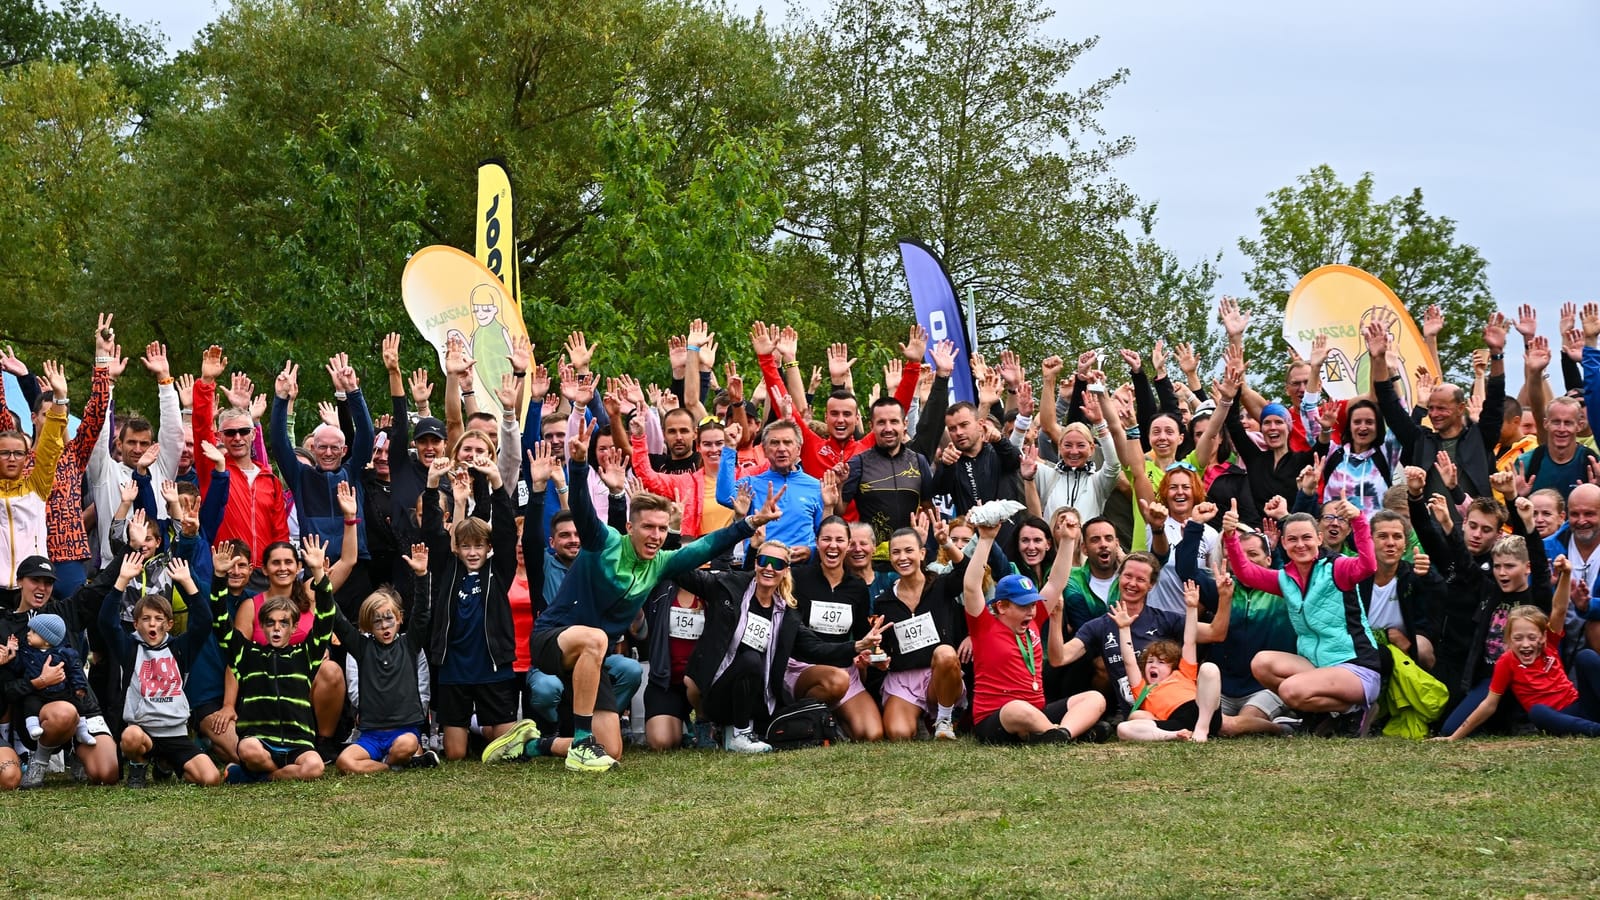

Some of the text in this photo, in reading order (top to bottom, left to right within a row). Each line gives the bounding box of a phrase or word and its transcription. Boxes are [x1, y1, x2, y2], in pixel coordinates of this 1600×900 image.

[675, 615, 694, 629] 154
[822, 610, 842, 623] 497
[747, 622, 766, 639] 486
[904, 624, 922, 640] 497
